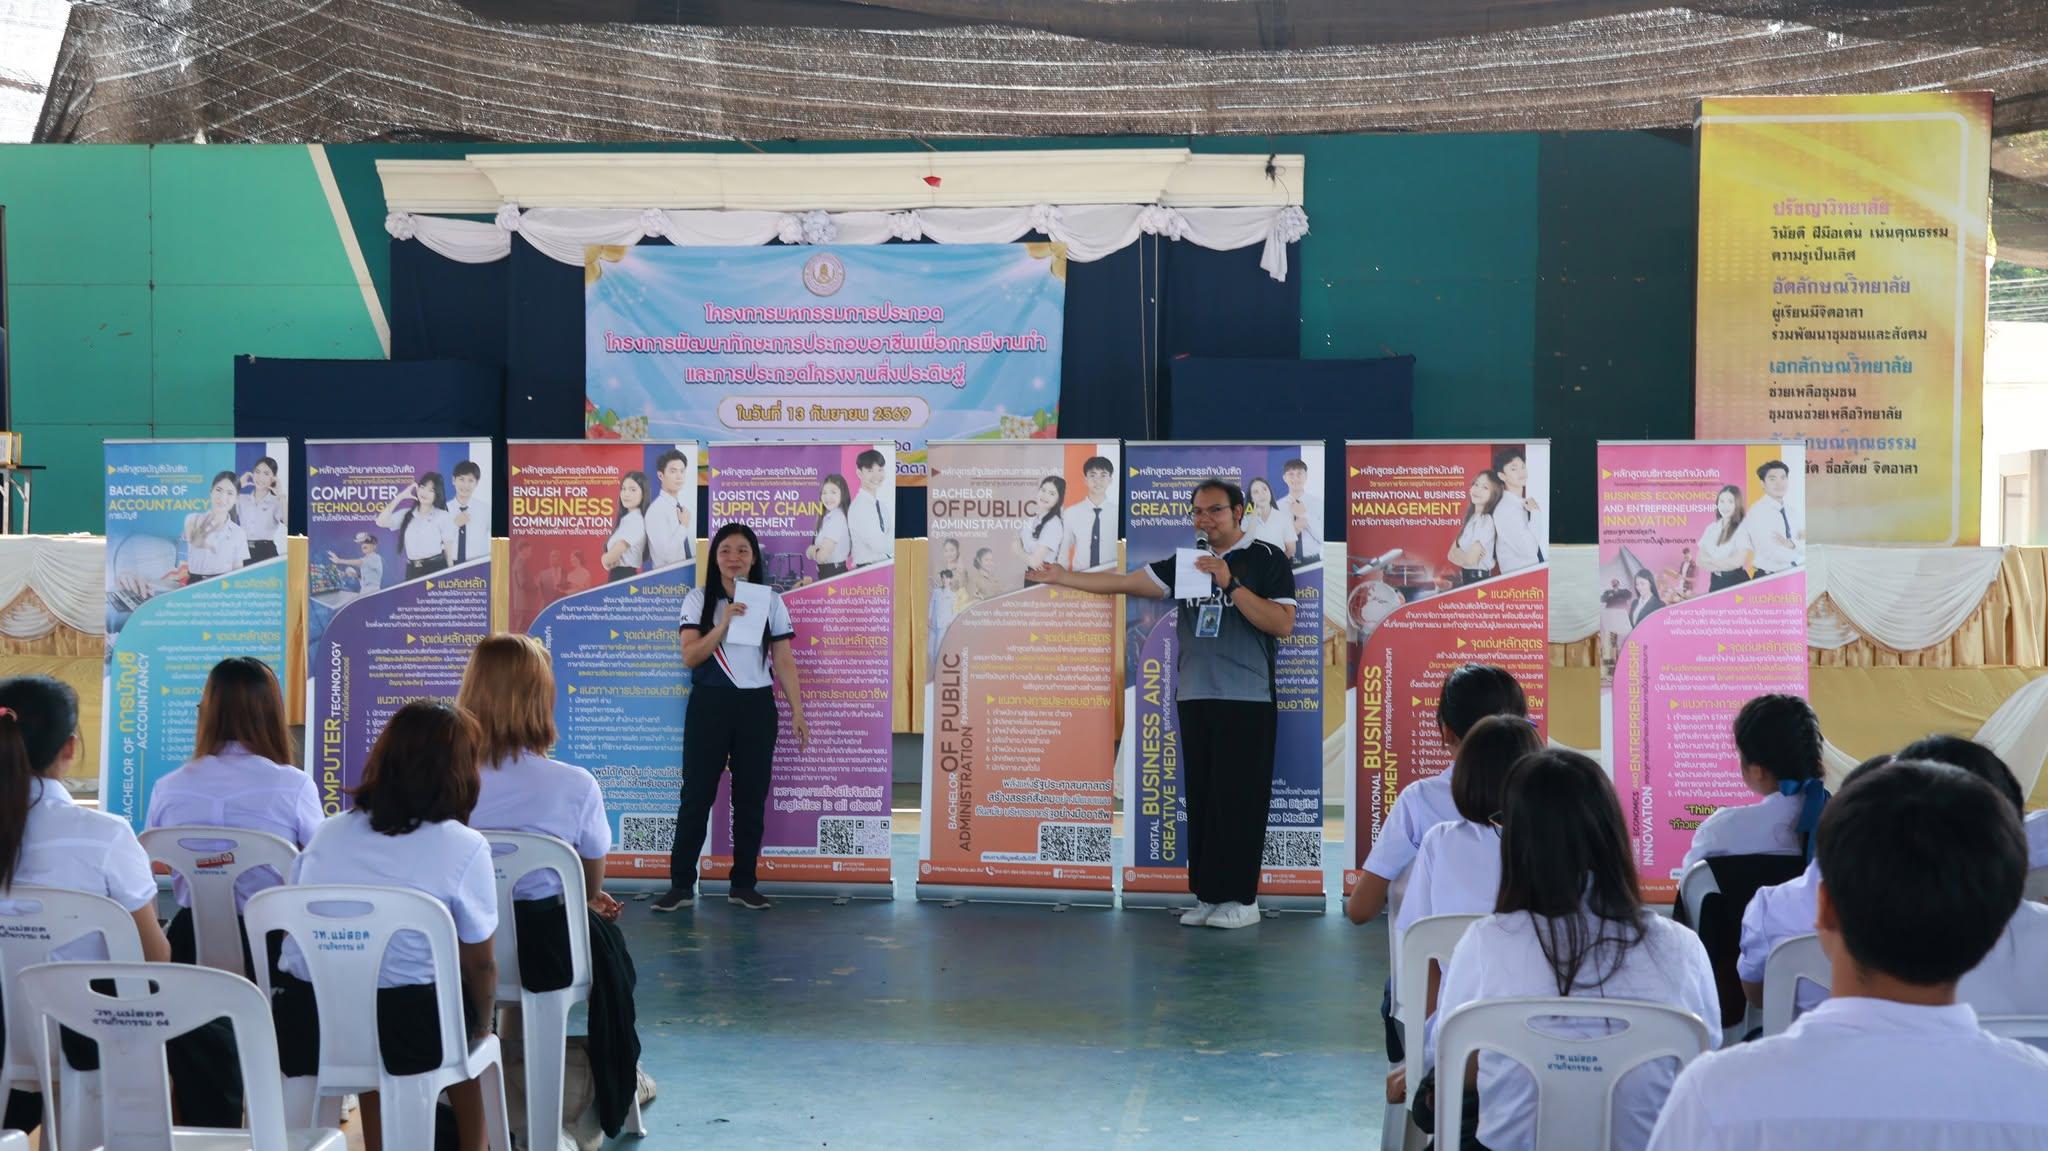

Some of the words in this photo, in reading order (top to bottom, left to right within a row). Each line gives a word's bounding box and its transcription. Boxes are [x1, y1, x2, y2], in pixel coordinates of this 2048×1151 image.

[1774, 197, 1890, 218] ปรัชญาวิทยาลัย
[1870, 222, 1949, 242] เน้นคุณธรรม
[1772, 244, 1856, 265] ความรู้เป็นเลิศ
[1773, 273, 1911, 295] อัตลักษณ์วิทยาลัย
[704, 302, 944, 323] โครงการมหกรรมการประกวด
[1772, 302, 1864, 322] ผู้เรียนมีจิตอาสา
[605, 327, 1047, 354] โครงการพัฒนาทักษะการประกอบอาชีพเพื่อการมีงานทำ
[1772, 324, 1927, 344] ร่วมพัฒนาชุมชนและสังคม
[1769, 352, 1913, 375] เอกลักษณ์วิทยาลัย
[685, 358, 966, 388] และการประกวดโครงงานสิ่งประดิษฐ์
[1769, 381, 1857, 402] ช่วยเหลือชุมชน
[736, 400, 782, 421] ในวันที่
[810, 404, 868, 421] กันยายน
[1769, 403, 1902, 424] ชุมชนช่วยเหลือวิทยาลัย
[721, 467, 817, 478] หลักสูตรบริหารธุรกิจบัณฑิต
[1140, 466, 1242, 478] หลักสูตรบริหารธุรกิจบัณฑิต
[1360, 465, 1464, 477] หลักสูตรบริหารธุรกิจบัณฑิต
[1613, 469, 1720, 480] หลักสูตรบริหารธุรกิจบัณฑิต
[1874, 461, 1918, 475] จิตอาสา
[109, 485, 169, 496] BACHELOR
[172, 485, 188, 496] OF
[311, 486, 399, 501] COMPUTER
[513, 486, 561, 497] ENGLISH
[565, 486, 588, 497] FOR
[712, 491, 770, 501] LOGISTICS
[774, 491, 800, 501] AND
[932, 489, 993, 498] BACHELOR
[1131, 491, 1169, 500] DIGITAL
[1352, 491, 1421, 500] INTERNATIONAL
[1424, 491, 1466, 500] BUSINESS
[1603, 491, 1653, 500] BUSINESS
[1656, 491, 1718, 500] ECONOMICS
[108, 499, 209, 512] ACCOUNTANCY
[512, 498, 614, 516] BUSINESS
[712, 502, 768, 516] SUPPLY
[775, 502, 823, 516] CHAIN
[932, 500, 960, 517] OF
[963, 500, 1038, 518] PUBLIC
[1130, 503, 1193, 516] CREATIV
[1351, 502, 1461, 515] MANAGEMENT
[1603, 504, 1624, 513] AND
[1627, 504, 1718, 513] ENTREPRENEURSHIP
[512, 517, 613, 527] COMMUNICATION
[932, 519, 1033, 530] ADMINISTRATION
[1351, 518, 1462, 528] การจัดการธุรกิจระหว่างประเทศ
[1603, 515, 1689, 528] INNOVATION
[438, 577, 487, 589] แนวคิดหลัก
[840, 585, 889, 597] แนวคิดหลัก
[1491, 587, 1544, 599] แนวคิดหลัก
[822, 634, 888, 648] จุดเด่นหลักสูตร
[1471, 637, 1543, 652] จุดเด่นหลักสูตร
[332, 641, 341, 717] TECHNOLOGY
[1143, 659, 1161, 706] AND
[116, 651, 138, 733] การบัญชี
[137, 652, 149, 749] ACCOUNTANCY
[942, 654, 961, 732] PUBLIC
[1628, 640, 1640, 772] ENTREPRENEURSHIP
[1364, 665, 1382, 769] BUSINESS
[123, 737, 134, 754] OF
[941, 741, 959, 772] OF
[1163, 731, 1177, 780] MEDIA
[324, 718, 341, 816] OMPUTER
[1143, 713, 1160, 816] BUSINESS
[960, 726, 973, 851] ADMINISTRATION
[773, 800, 821, 813] Logistics
[823, 801, 833, 811] is
[834, 800, 848, 811] all
[850, 800, 882, 812] about
[948, 773, 958, 830] BACHELOR
[1288, 799, 1319, 811] Digital
[1163, 786, 1176, 861] CREATIVE
[1642, 786, 1654, 866] INNOVATION
[1150, 819, 1160, 860] DIGITAL
[313, 928, 370, 941] วท.แม่สอด
